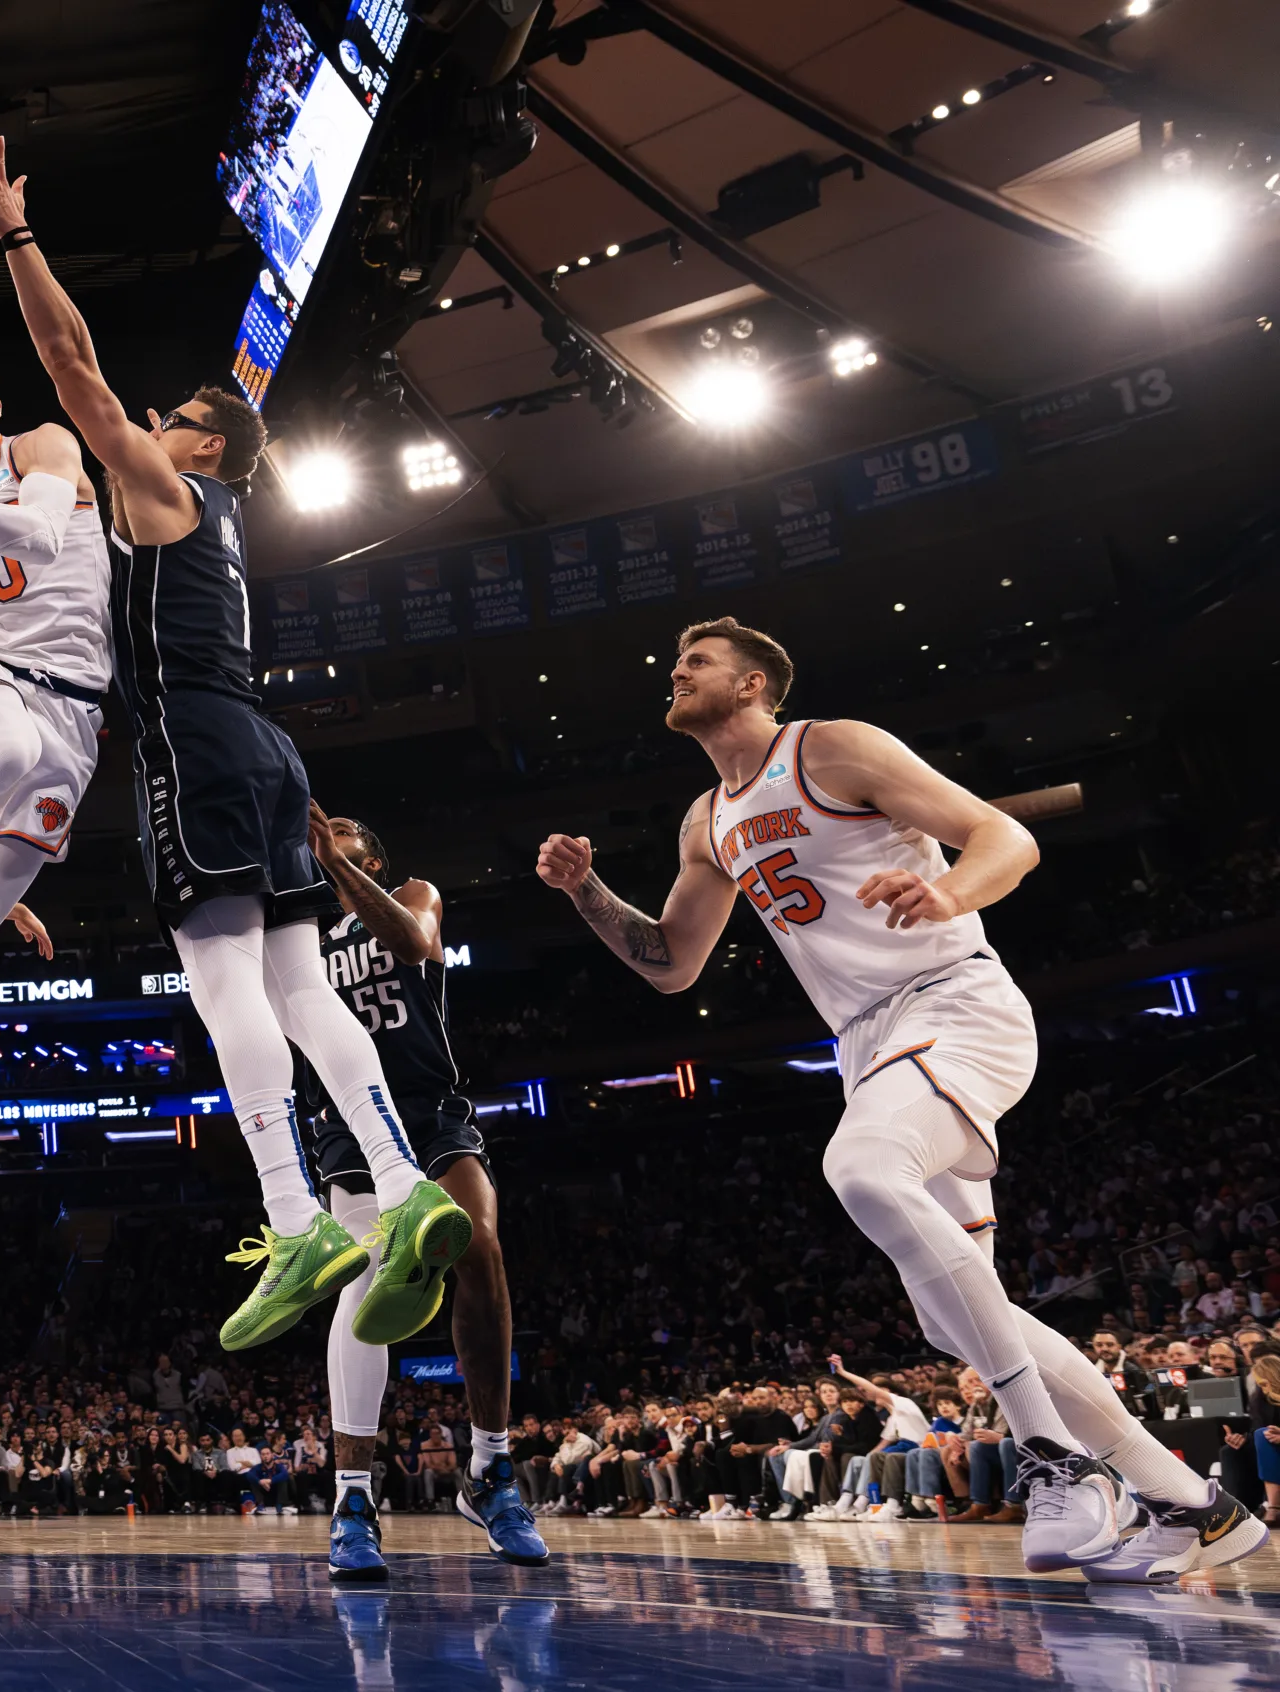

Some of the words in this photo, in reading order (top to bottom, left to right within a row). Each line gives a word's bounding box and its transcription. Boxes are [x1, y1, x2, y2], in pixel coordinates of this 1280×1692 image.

[358, 65, 372, 92] 20
[1110, 368, 1172, 414] 13
[912, 433, 971, 482] 98
[549, 564, 598, 584] 2011-12
[736, 807, 812, 850] YORK
[737, 848, 826, 935] 55
[352, 980, 408, 1035] 55
[24, 1103, 96, 1118] MAVERICKS
[130, 1096, 136, 1106] 1
[142, 1107, 151, 1116] 7
[202, 1103, 212, 1114] 3
